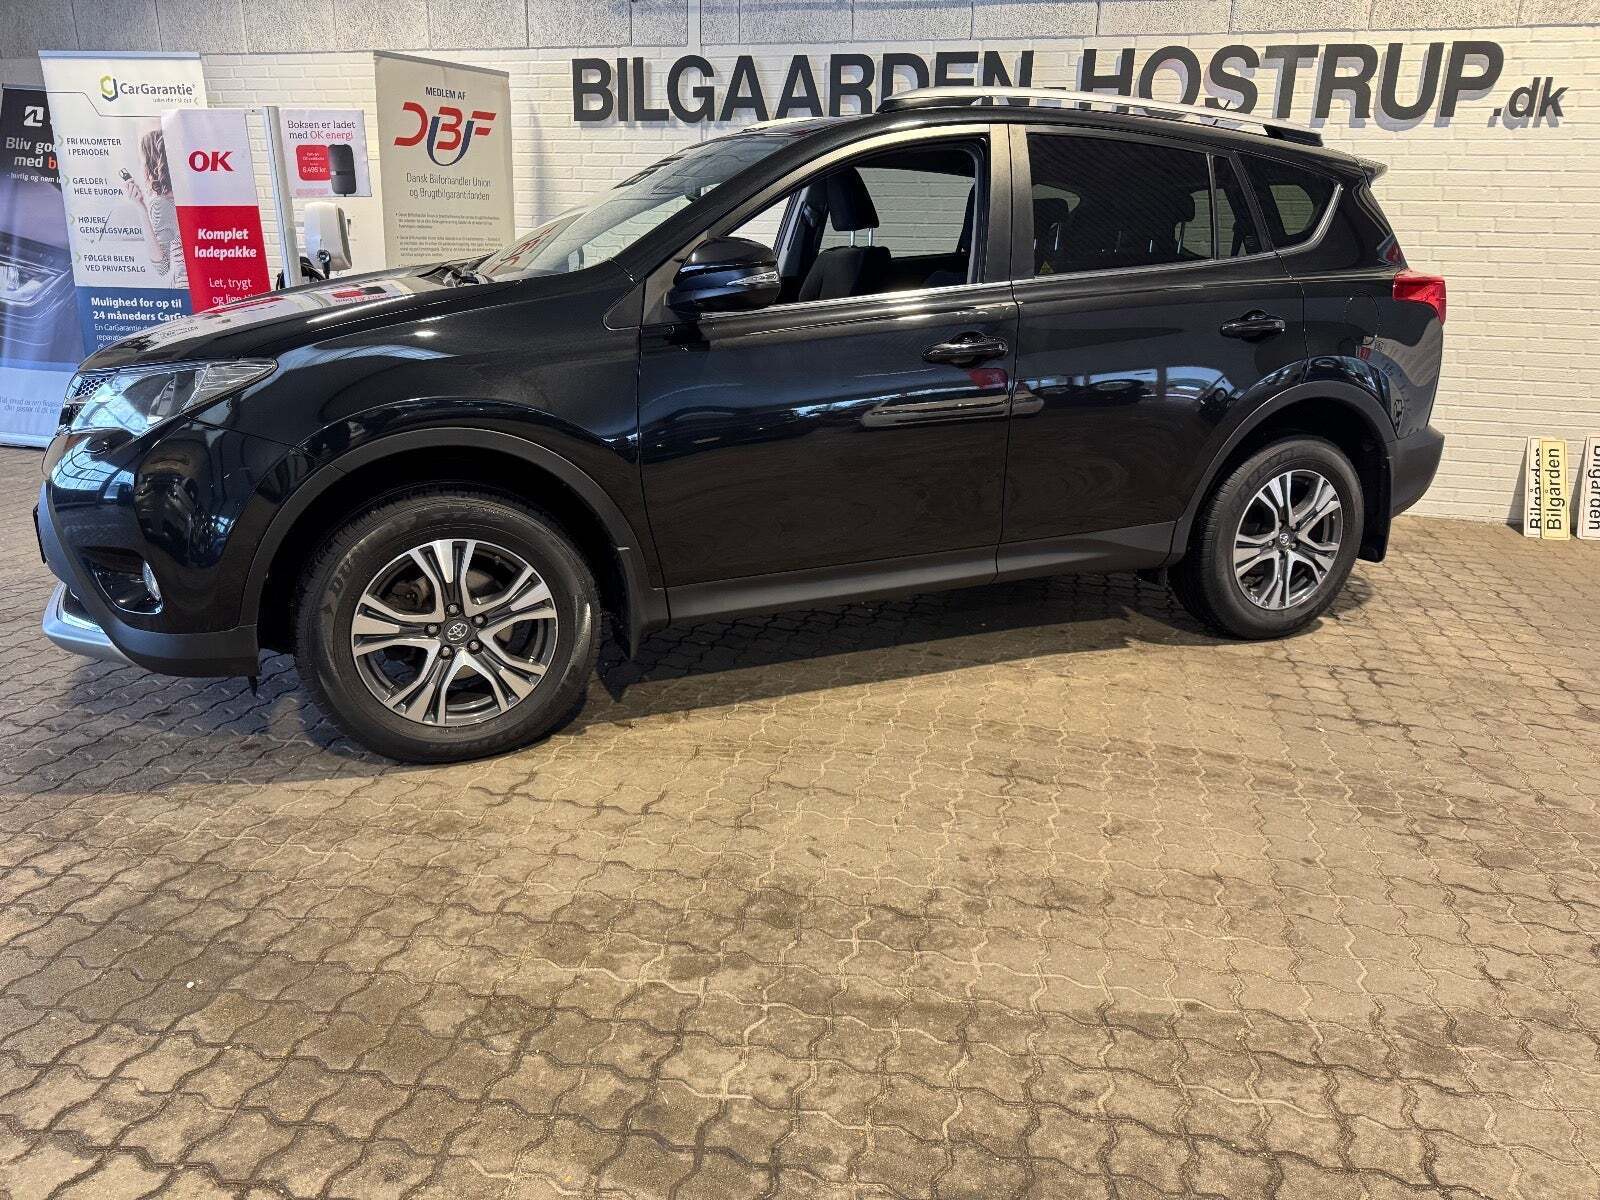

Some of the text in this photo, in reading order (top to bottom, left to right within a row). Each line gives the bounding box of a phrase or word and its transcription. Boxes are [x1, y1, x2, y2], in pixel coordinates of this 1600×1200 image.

[572, 52, 1034, 121] BILGAARDEN
[425, 87, 467, 101] MEDLEM AF
[287, 120, 321, 129] Boksen
[333, 120, 356, 129] ladet
[290, 130, 353, 142] med OK energi
[6, 137, 32, 150] Bliv
[79, 138, 122, 147] KILOMETER
[72, 148, 109, 156] PERIODEN
[14, 155, 44, 168] med
[189, 150, 235, 172] OK
[73, 177, 104, 185] GÆLDER
[406, 173, 428, 183] Dansk
[472, 177, 492, 188] Union
[74, 187, 124, 196] HELE EUROPA
[409, 189, 419, 199] og
[78, 216, 106, 224] HØJERE
[80, 226, 143, 236] GENSALGSVÆRDI
[198, 227, 249, 244] Komplet
[83, 254, 136, 263] FØLGER BILEN
[195, 246, 257, 261] ladepakke
[85, 264, 147, 273] VED PRIVATSALG
[209, 278, 253, 291] Let, trygt
[90, 296, 183, 310] Mulighed for op til
[212, 296, 225, 306] og
[93, 310, 107, 320] 24
[108, 310, 156, 321] måneders
[94, 323, 104, 332] En
[1545, 448, 1565, 530] Bilgården
